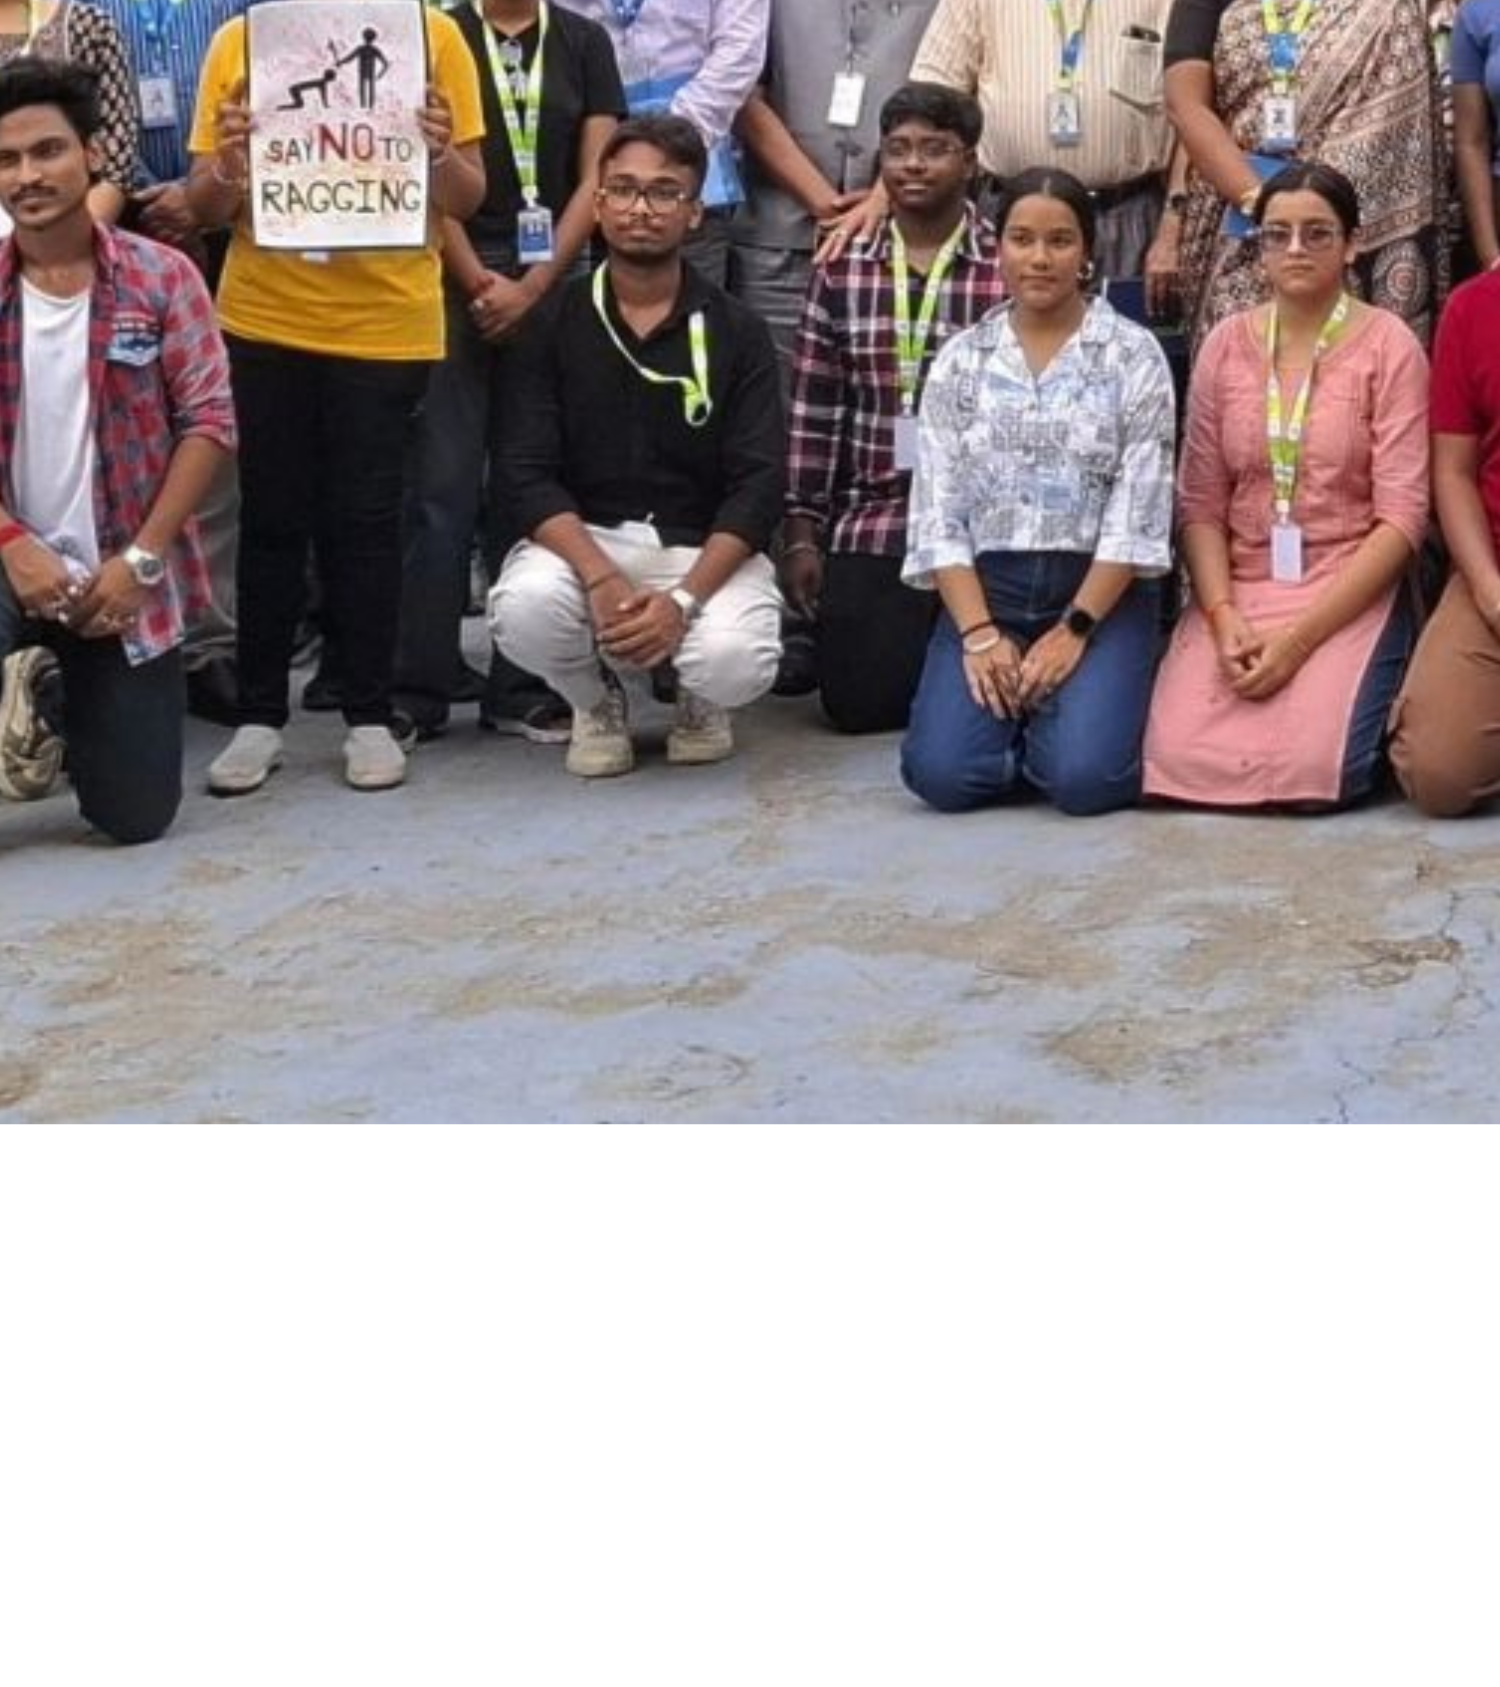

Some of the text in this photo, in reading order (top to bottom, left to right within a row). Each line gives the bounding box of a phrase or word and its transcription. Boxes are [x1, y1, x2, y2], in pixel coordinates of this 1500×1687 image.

[265, 122, 413, 165] SAY NO TO
[261, 178, 422, 215] RAGGING
